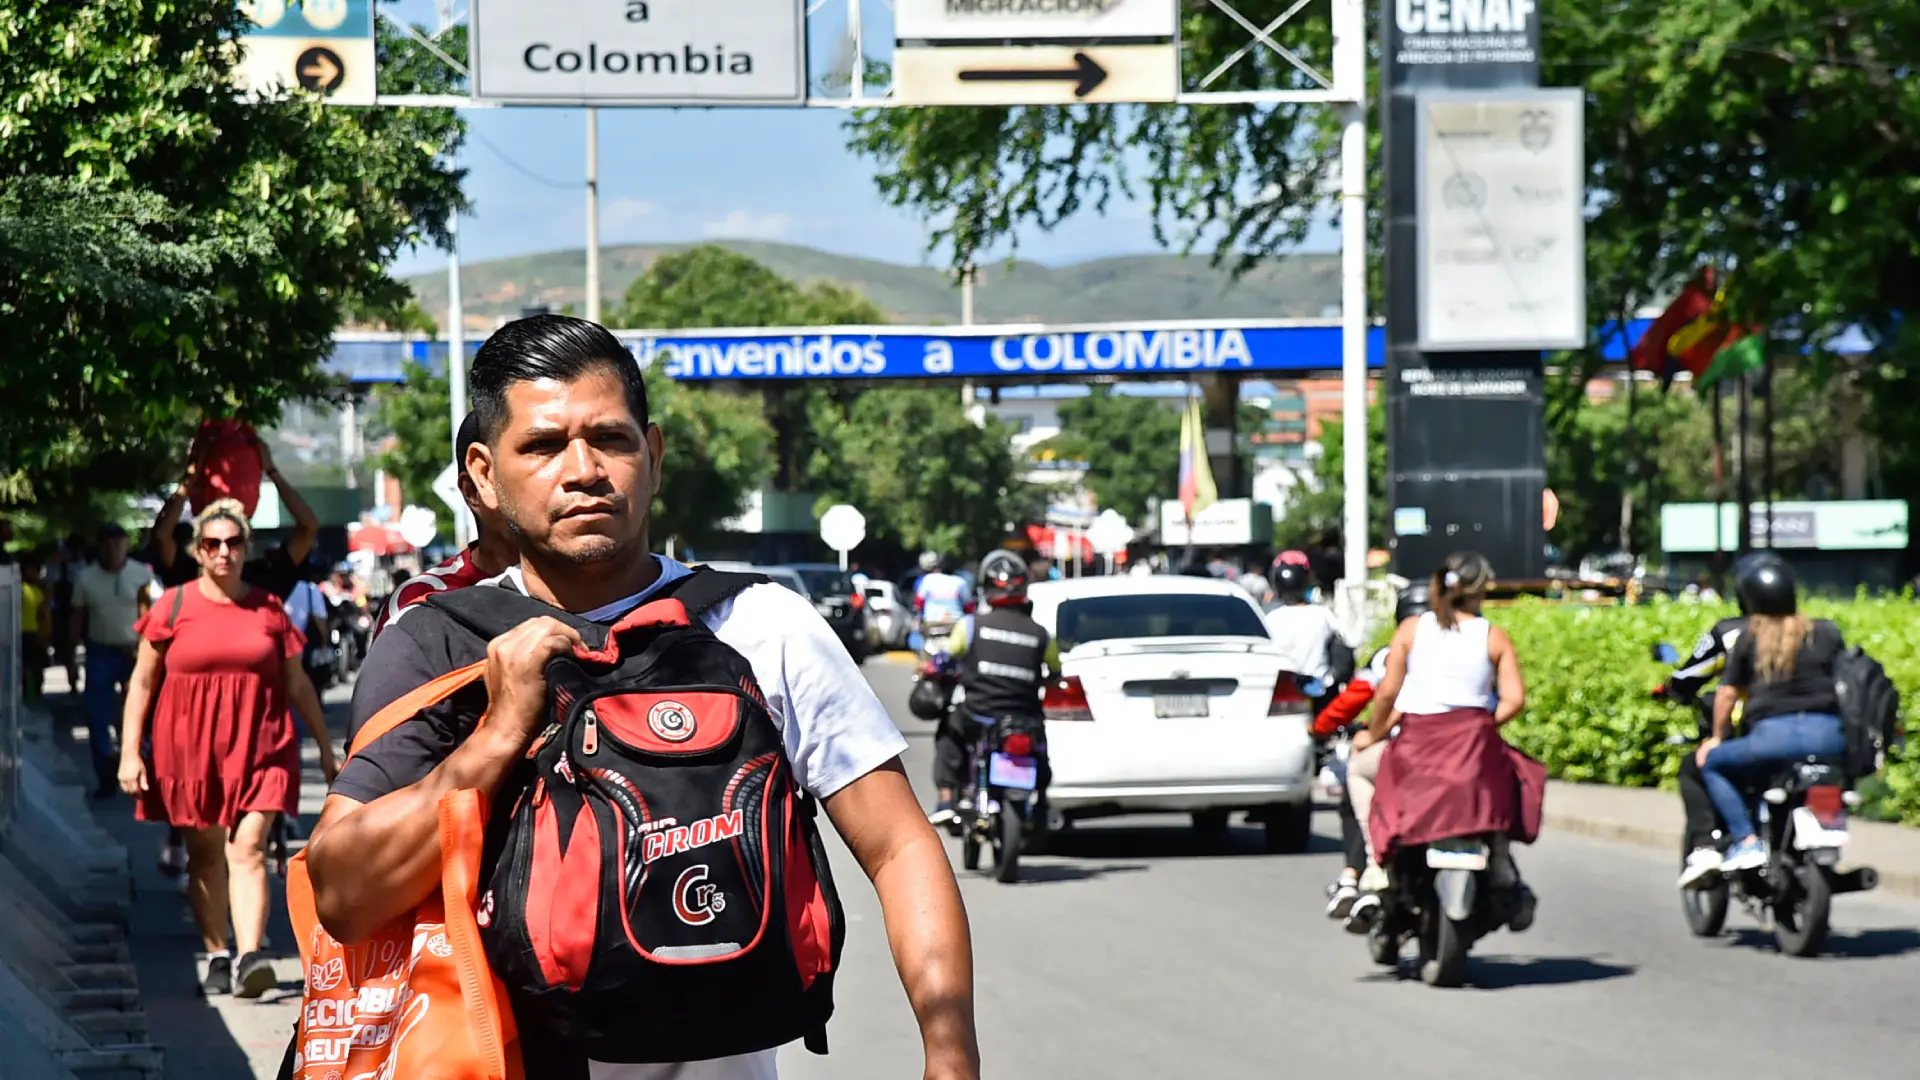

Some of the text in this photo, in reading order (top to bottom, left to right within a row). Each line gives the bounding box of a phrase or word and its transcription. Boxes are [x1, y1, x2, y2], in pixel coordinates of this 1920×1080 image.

[625, 0, 650, 22] a
[1395, 0, 1535, 33] CENAF
[523, 42, 753, 74] Colombia
[923, 339, 954, 374] a
[990, 329, 1253, 371] COLOMBIA
[642, 808, 744, 865] CROM
